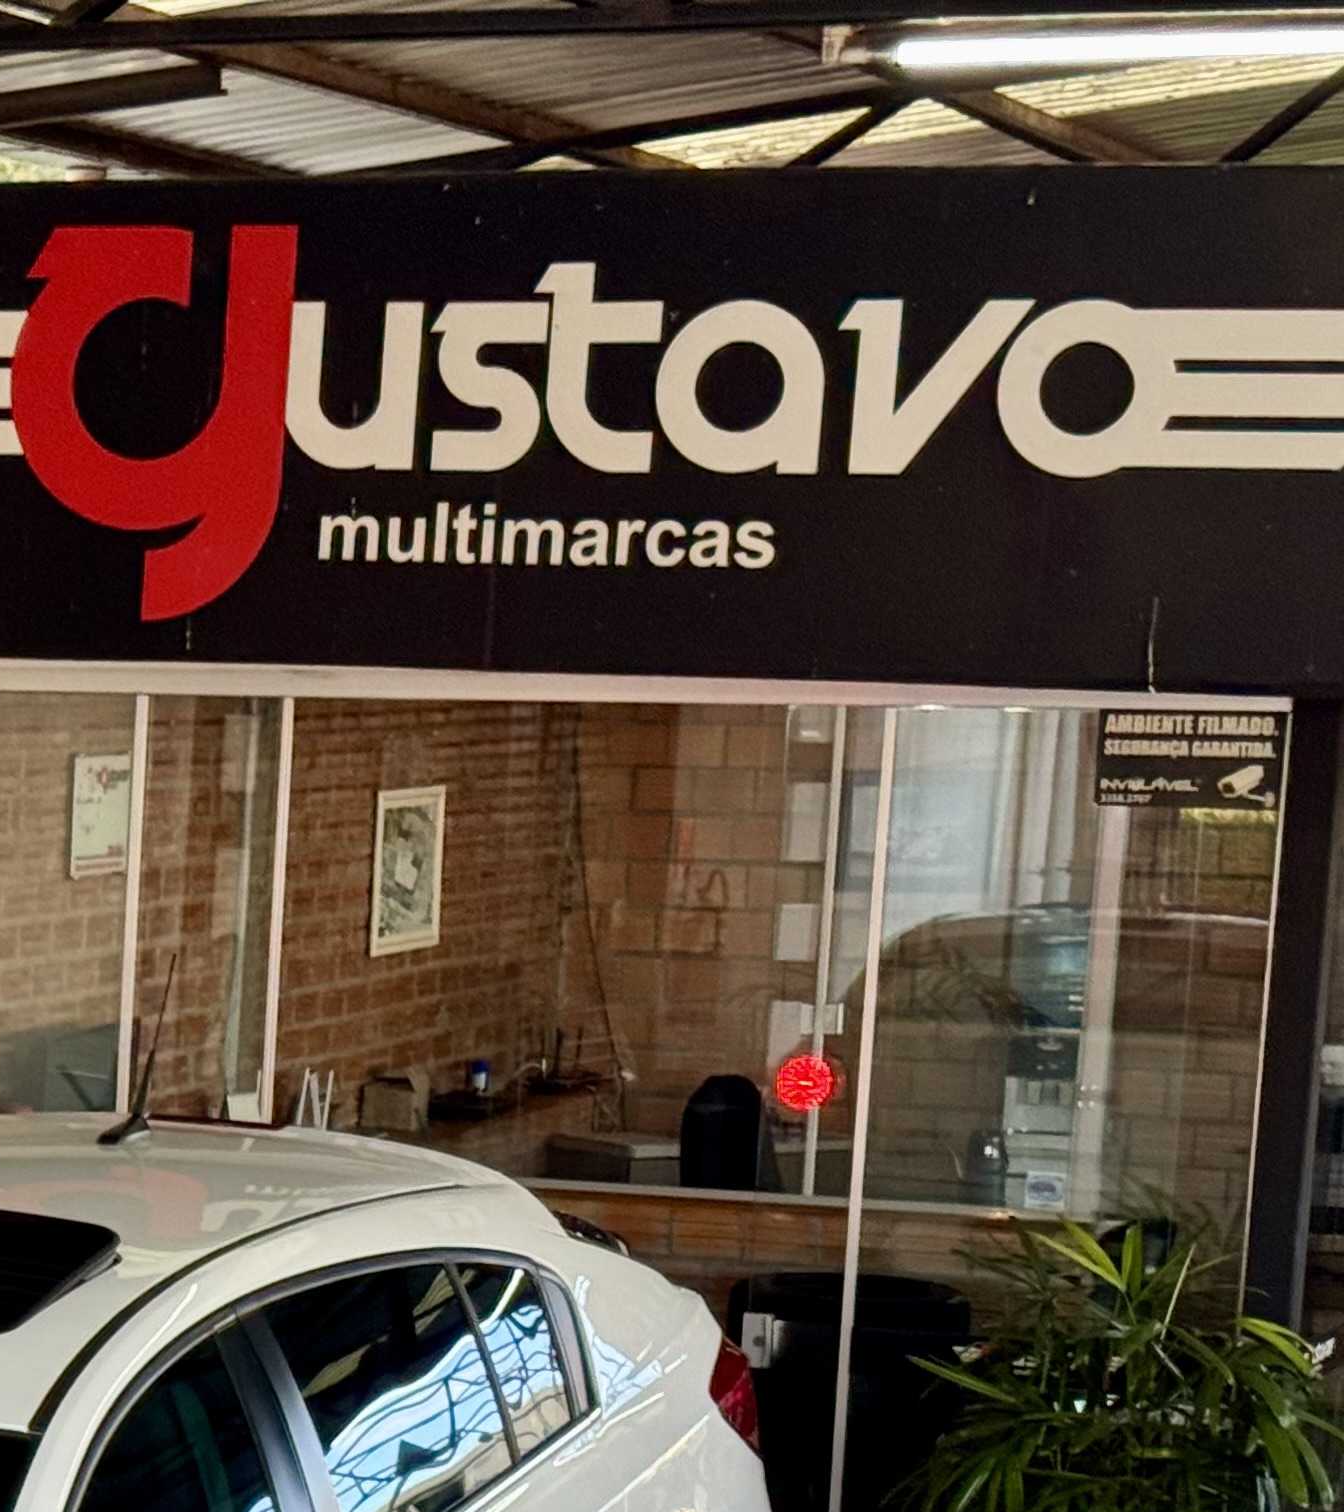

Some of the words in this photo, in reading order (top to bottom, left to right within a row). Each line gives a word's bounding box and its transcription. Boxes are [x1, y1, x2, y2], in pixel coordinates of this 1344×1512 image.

[10, 222, 1146, 621] gustavo
[316, 501, 776, 570] multimarcas
[1104, 714, 1194, 734] AMBIENTE
[1197, 716, 1279, 736] FILMADO.
[1103, 739, 1189, 758] SEGURANÇA
